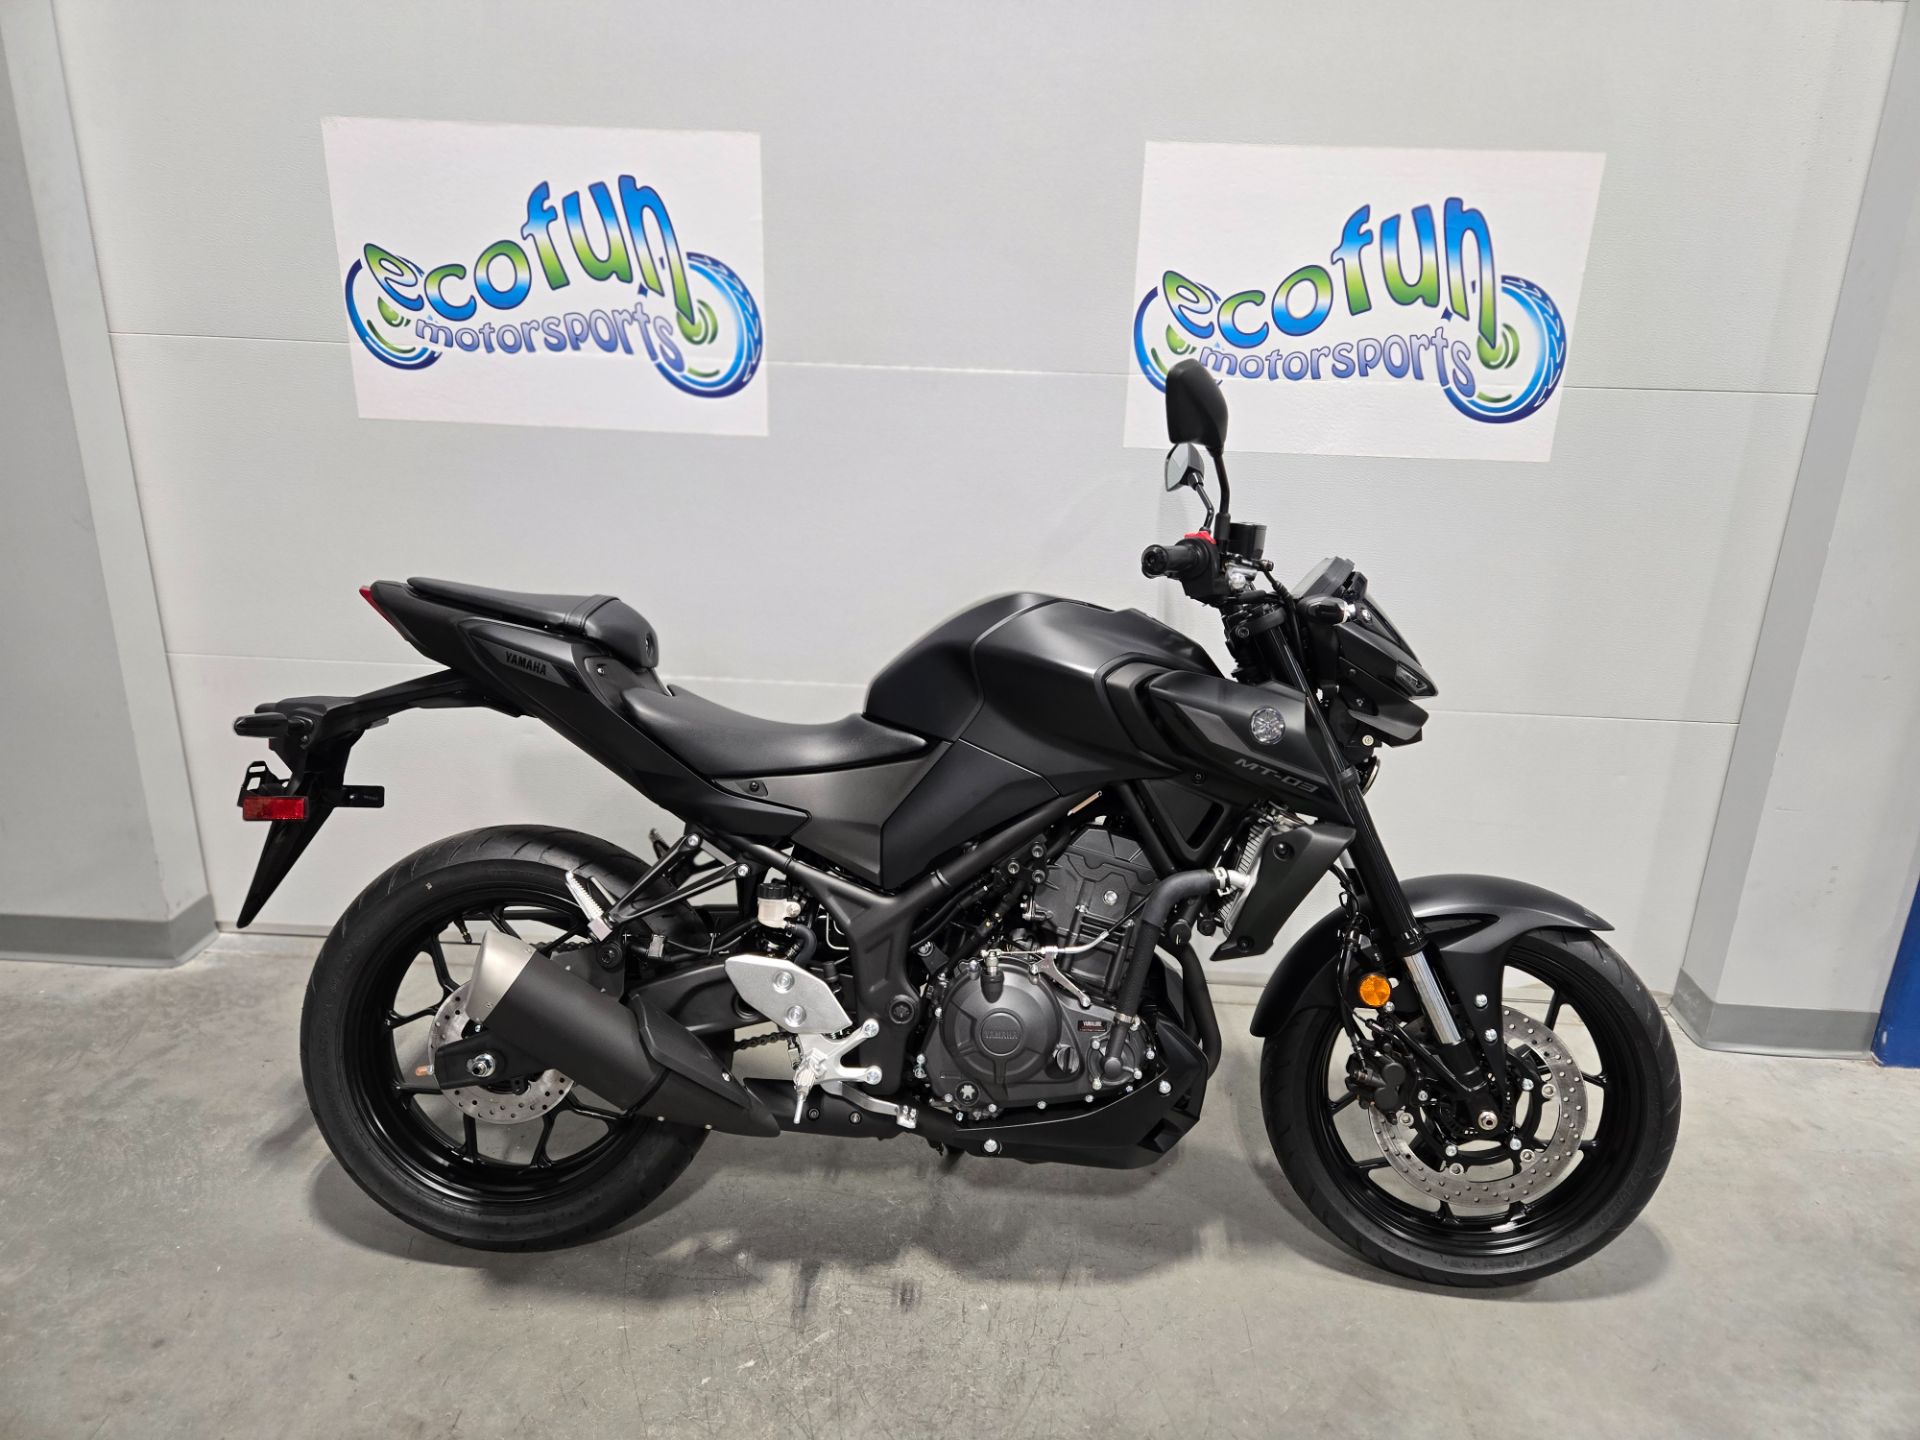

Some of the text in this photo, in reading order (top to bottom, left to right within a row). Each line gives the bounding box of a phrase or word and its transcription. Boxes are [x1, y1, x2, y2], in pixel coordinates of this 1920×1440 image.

[363, 174, 696, 325] ecofun
[1162, 197, 1497, 350] ecofun
[415, 301, 686, 373] motorsports
[1199, 327, 1477, 398] motorsports
[505, 651, 547, 676] YAMAHA
[1234, 758, 1319, 793] MT-03
